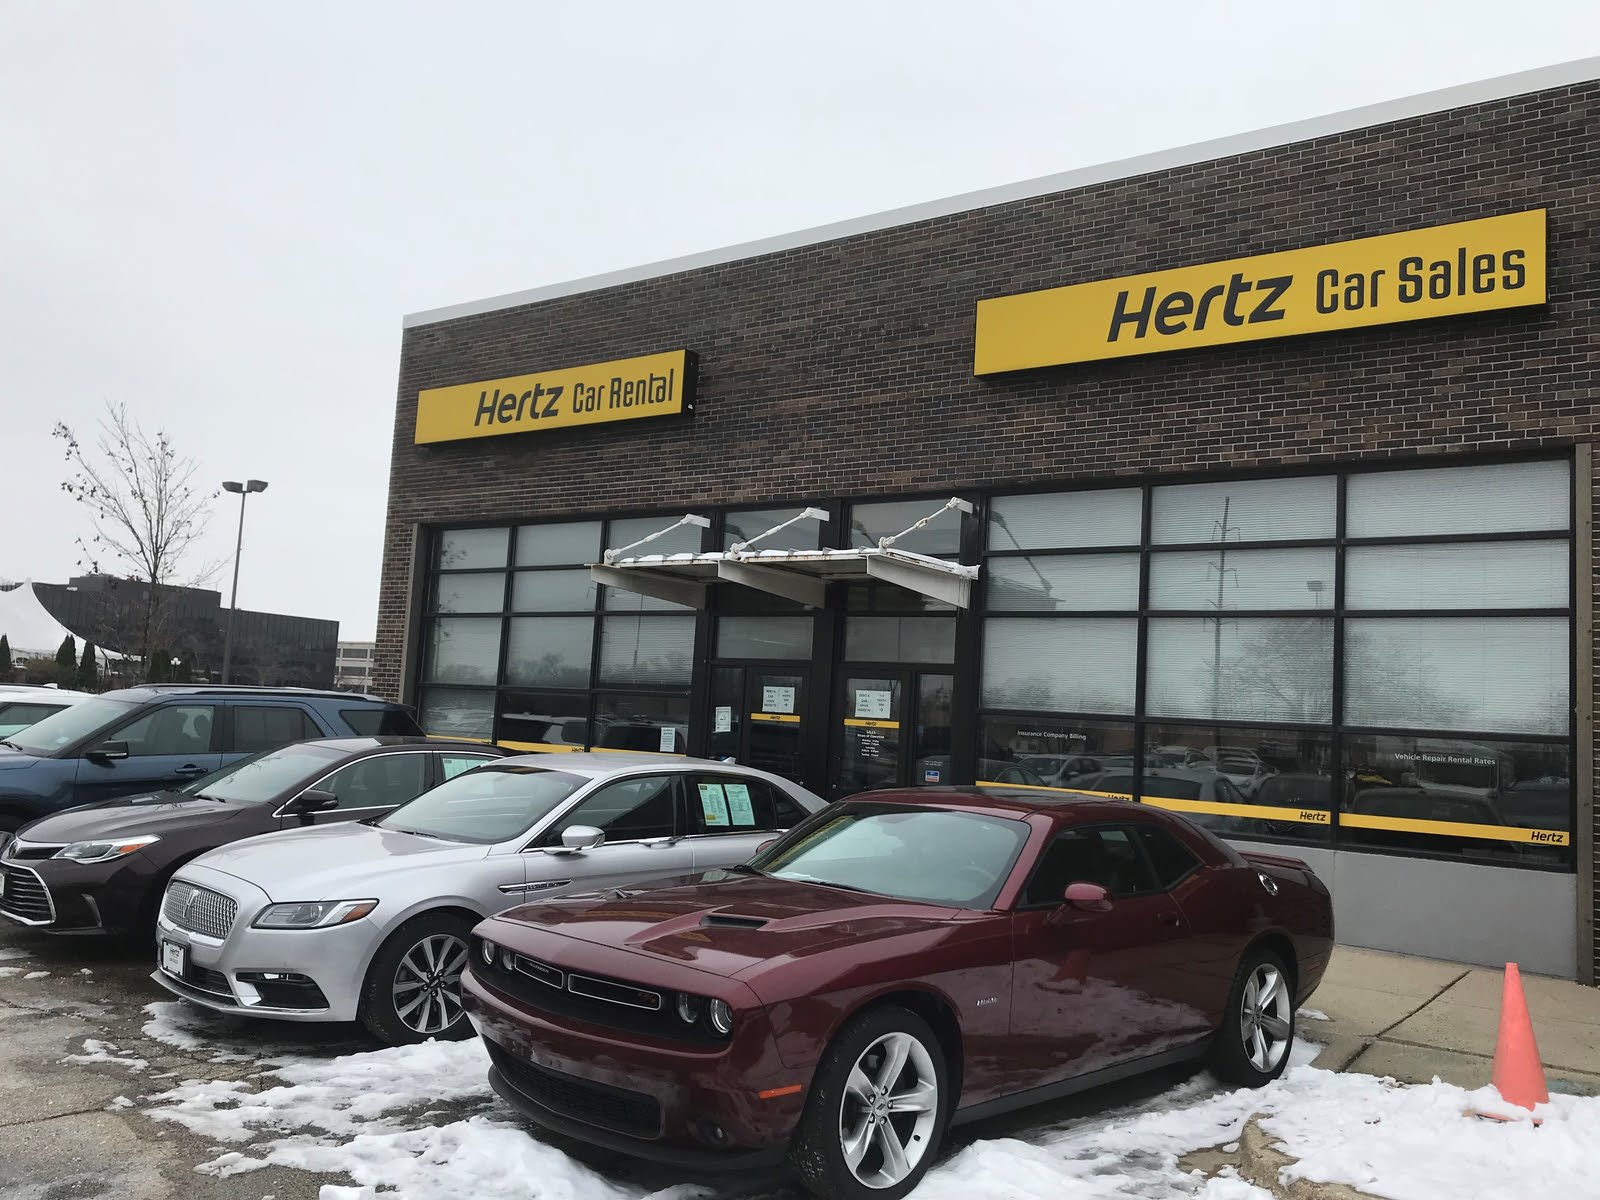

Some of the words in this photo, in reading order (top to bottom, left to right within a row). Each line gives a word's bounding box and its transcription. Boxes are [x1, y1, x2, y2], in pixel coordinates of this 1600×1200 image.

[1107, 273, 1294, 342] Hertz
[1316, 269, 1385, 314] Car
[1398, 247, 1526, 303] Sales
[474, 383, 564, 426] Hertz
[573, 382, 605, 413] Car
[609, 368, 675, 409] Rental
[1043, 731, 1068, 740] Company
[1395, 752, 1421, 761] Vehicle
[1422, 754, 1446, 763] Repair
[1448, 756, 1473, 764] Rental
[1474, 757, 1496, 765] Rates
[1299, 811, 1327, 821] Hertz
[1531, 831, 1564, 843] Hertz
